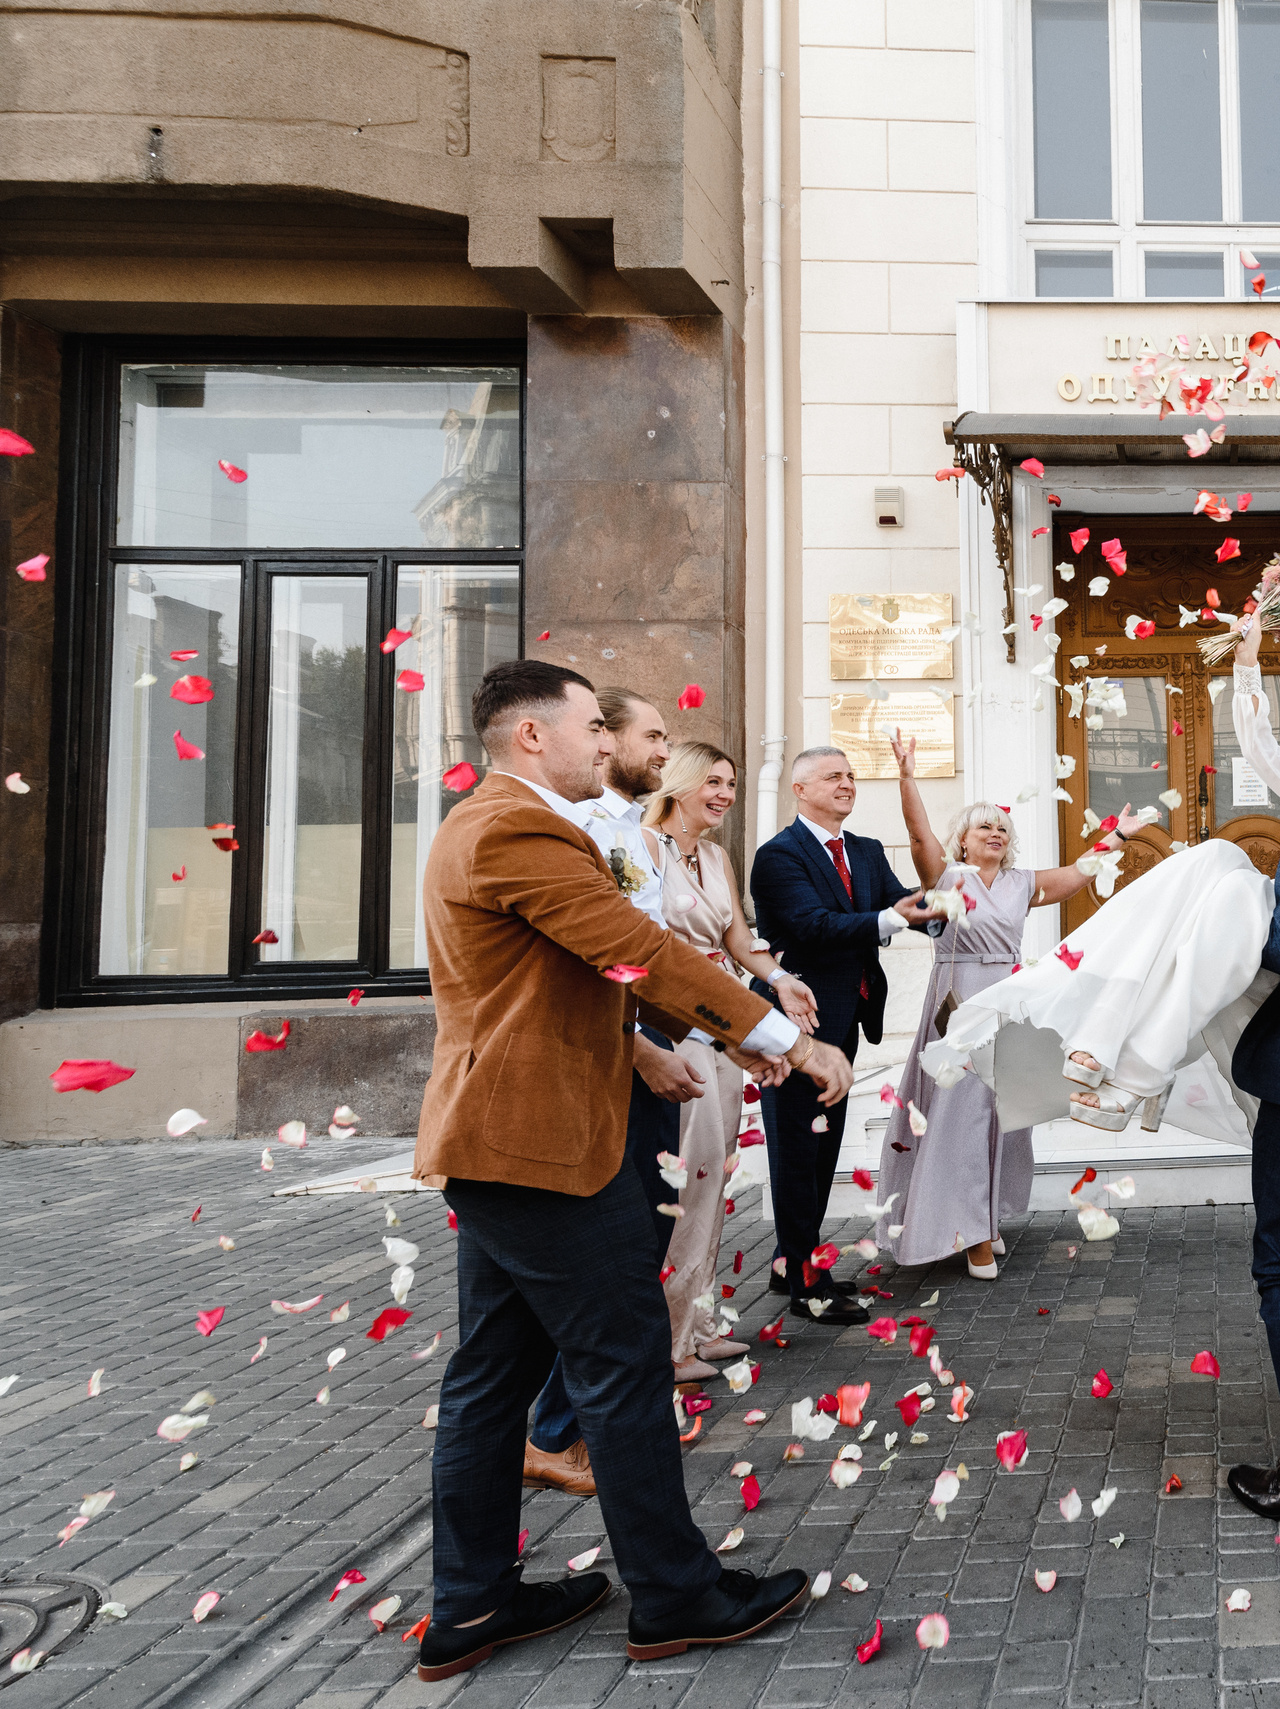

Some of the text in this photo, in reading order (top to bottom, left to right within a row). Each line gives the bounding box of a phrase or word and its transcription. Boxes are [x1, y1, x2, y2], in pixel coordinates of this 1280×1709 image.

[1106, 333, 1248, 367] ПАЛАЦ
[839, 627, 941, 636] ОДЕСЬКА МІСЬКА РАДА
